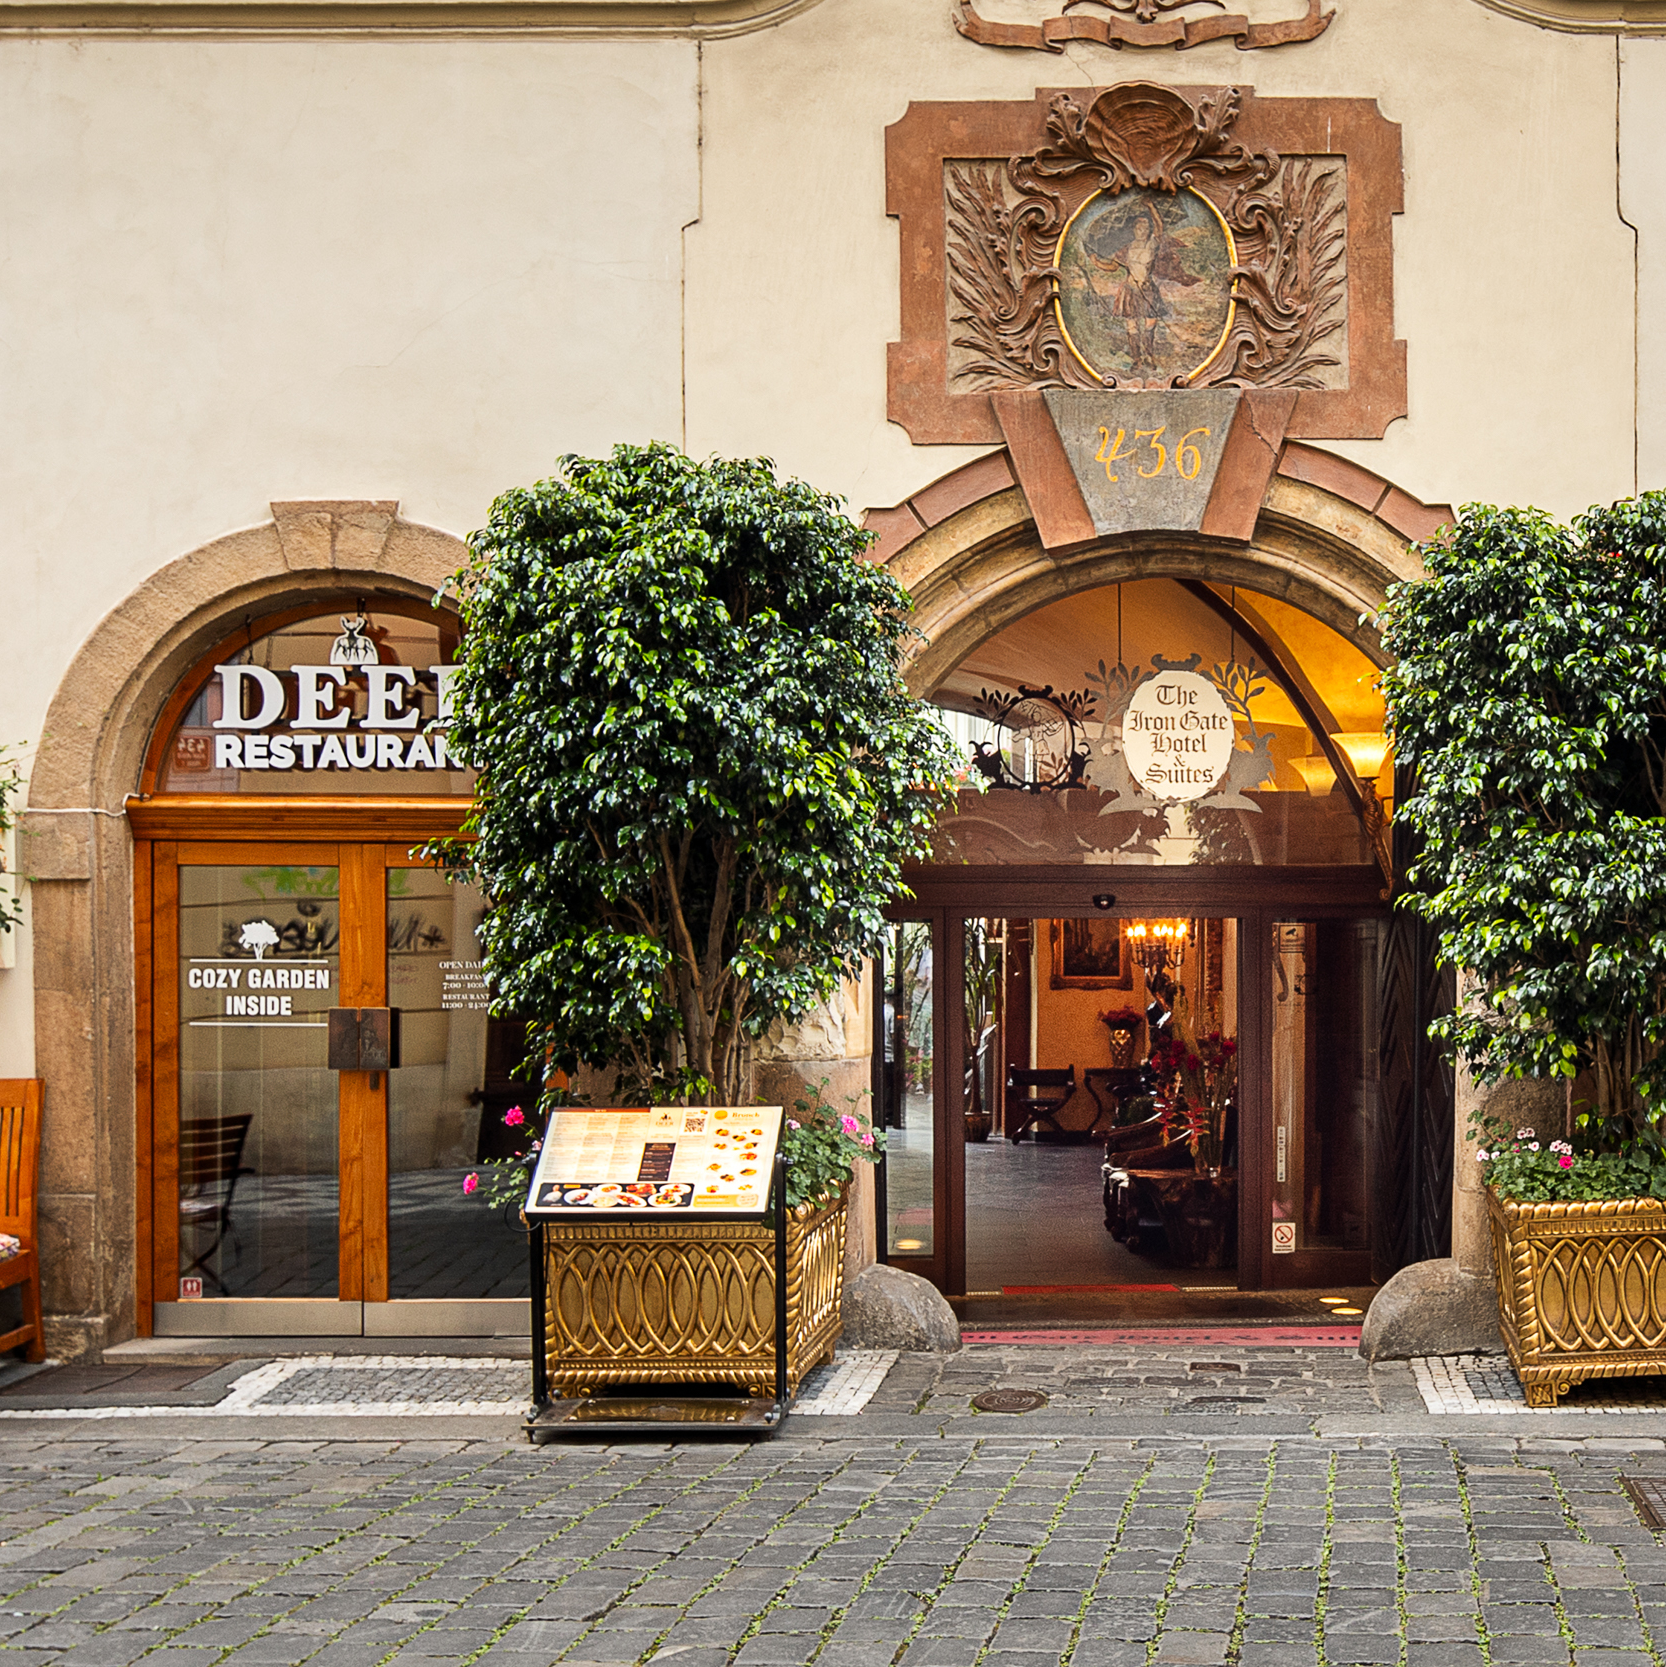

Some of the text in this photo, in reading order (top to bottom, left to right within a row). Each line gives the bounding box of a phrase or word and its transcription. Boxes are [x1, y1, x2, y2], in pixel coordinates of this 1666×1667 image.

[1094, 425, 1210, 482] 436
[1155, 684, 1198, 710] The
[1128, 710, 1229, 732] Iron Gate
[215, 734, 484, 768] RESTAURAN
[1151, 732, 1207, 754] Hotel
[1174, 754, 1186, 767] &
[1145, 764, 1214, 785] Suites
[438, 960, 463, 969] OPEN
[188, 968, 330, 990] COZY GARDEN
[442, 982, 462, 990] 7:00
[226, 996, 292, 1016] INSIDE
